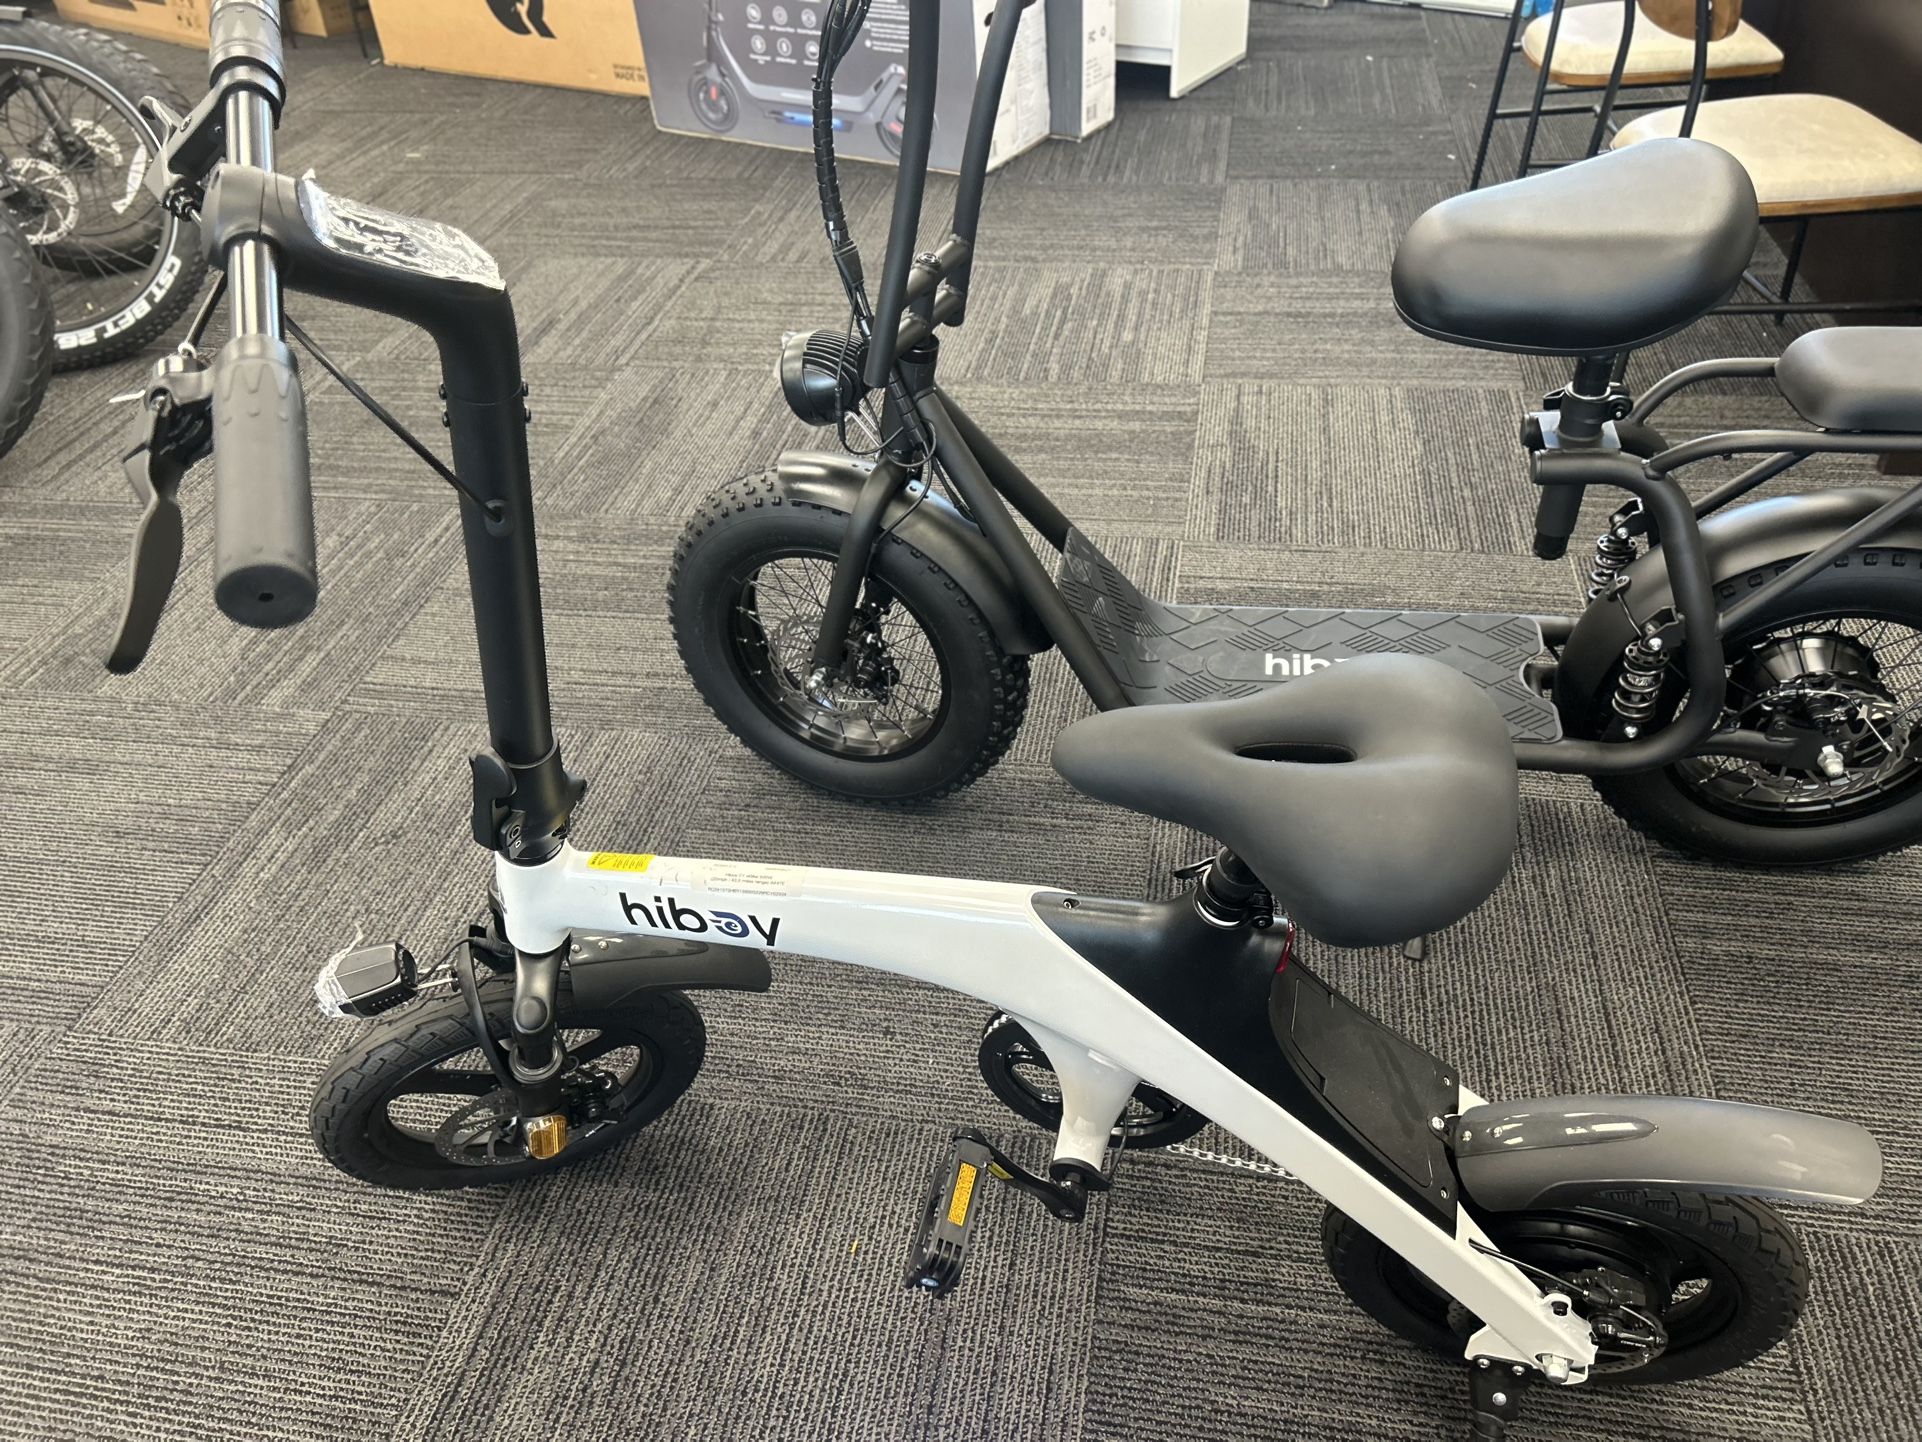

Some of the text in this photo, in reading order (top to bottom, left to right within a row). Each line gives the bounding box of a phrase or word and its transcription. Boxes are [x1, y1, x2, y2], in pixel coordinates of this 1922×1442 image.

[152, 255, 182, 303] CST
[1265, 653, 1349, 676] hib
[618, 891, 781, 947] hiboy
